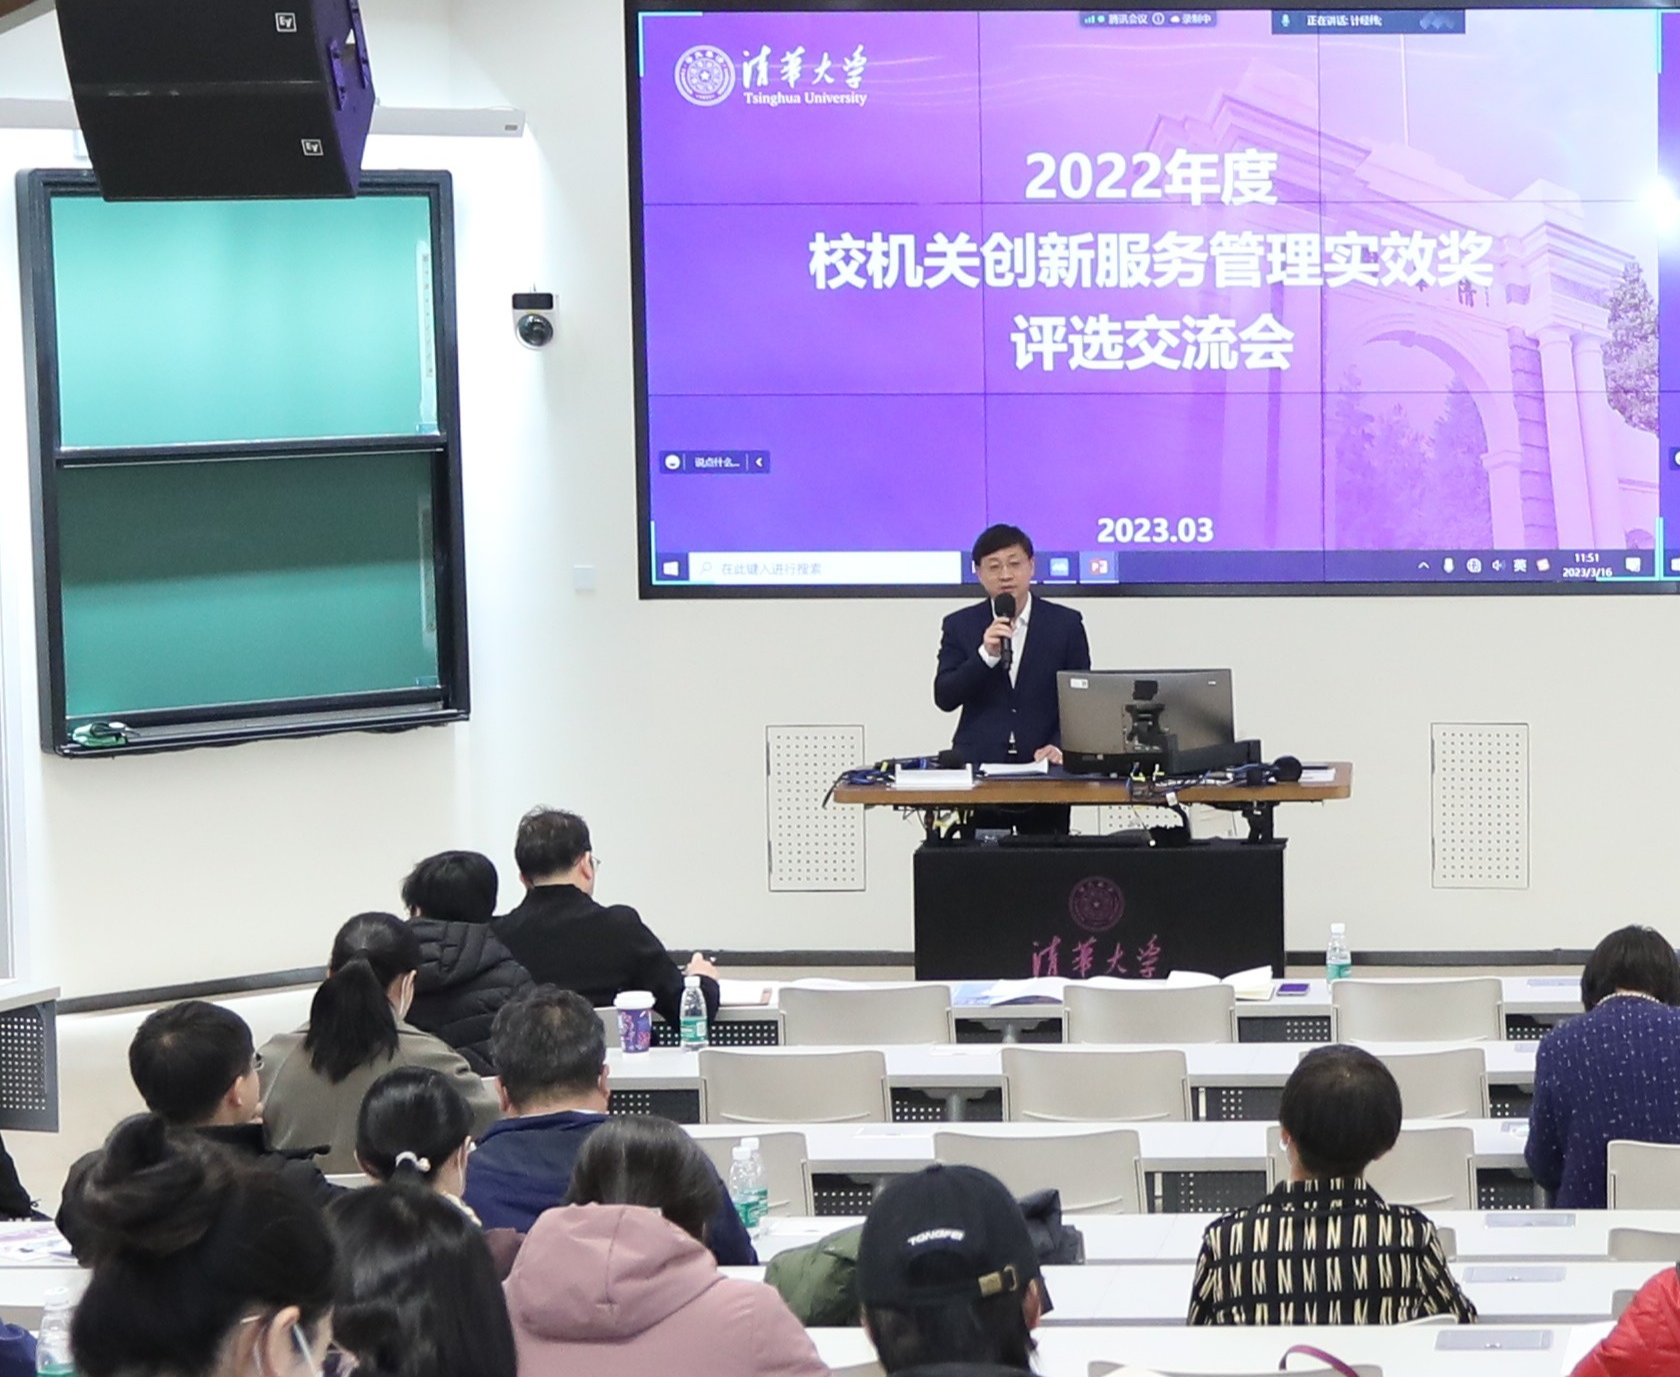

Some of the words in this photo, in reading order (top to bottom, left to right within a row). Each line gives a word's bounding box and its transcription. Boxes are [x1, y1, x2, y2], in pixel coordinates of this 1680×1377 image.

[743, 91, 802, 107] Tsinghua
[804, 91, 868, 107] University
[1024, 147, 1279, 207] 2022年度
[808, 229, 1495, 292] 校机关创新服务管理实效奖
[1009, 312, 1296, 372] 评选交流会
[1096, 516, 1215, 544] 2023.03
[1574, 552, 1600, 563] 11:51
[721, 562, 822, 576] 在此键入进行搜索
[1513, 559, 1527, 573] 英
[1562, 567, 1613, 578] 2023/3/16
